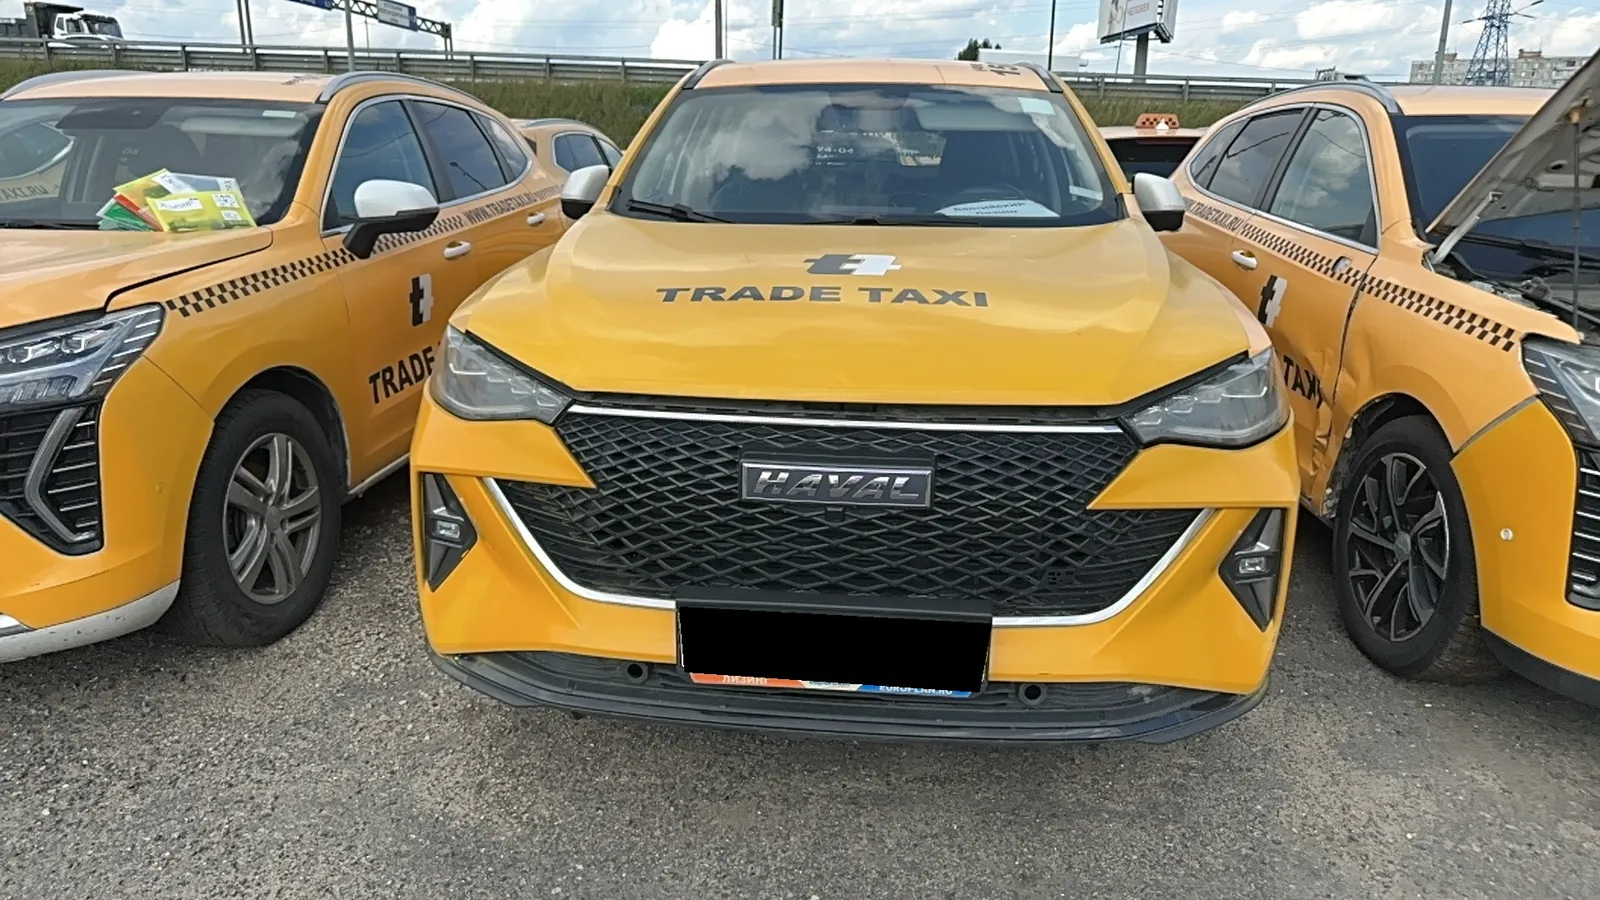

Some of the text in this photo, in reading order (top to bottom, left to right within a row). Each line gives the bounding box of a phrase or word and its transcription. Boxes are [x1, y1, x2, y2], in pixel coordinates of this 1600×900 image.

[656, 286, 989, 307] TRADE TAXI
[368, 346, 435, 405] TRADE
[1283, 354, 1323, 410] TAXI
[753, 471, 919, 500] HAVAL
